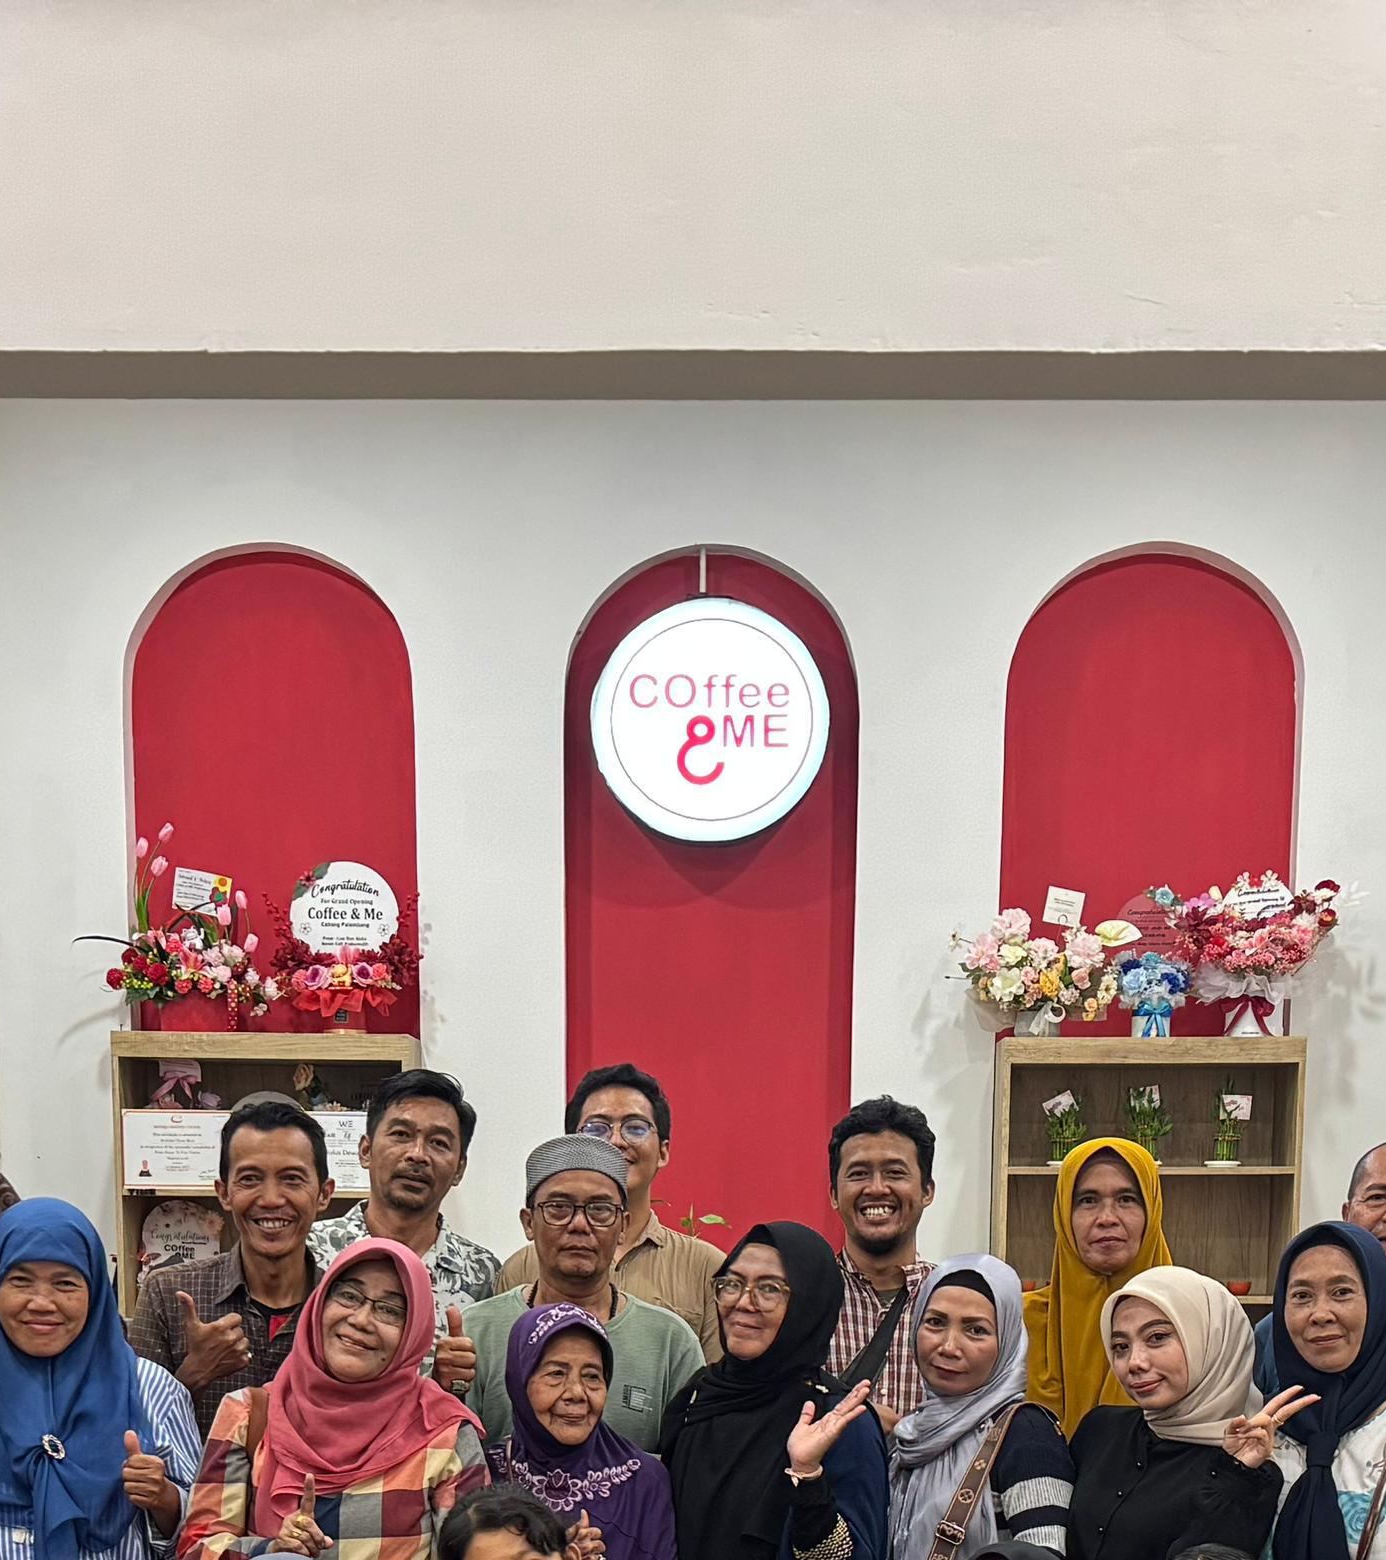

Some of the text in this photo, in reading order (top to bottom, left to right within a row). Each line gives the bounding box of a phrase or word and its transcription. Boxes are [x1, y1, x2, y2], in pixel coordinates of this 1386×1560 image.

[308, 907, 383, 920] Coffee & Me
